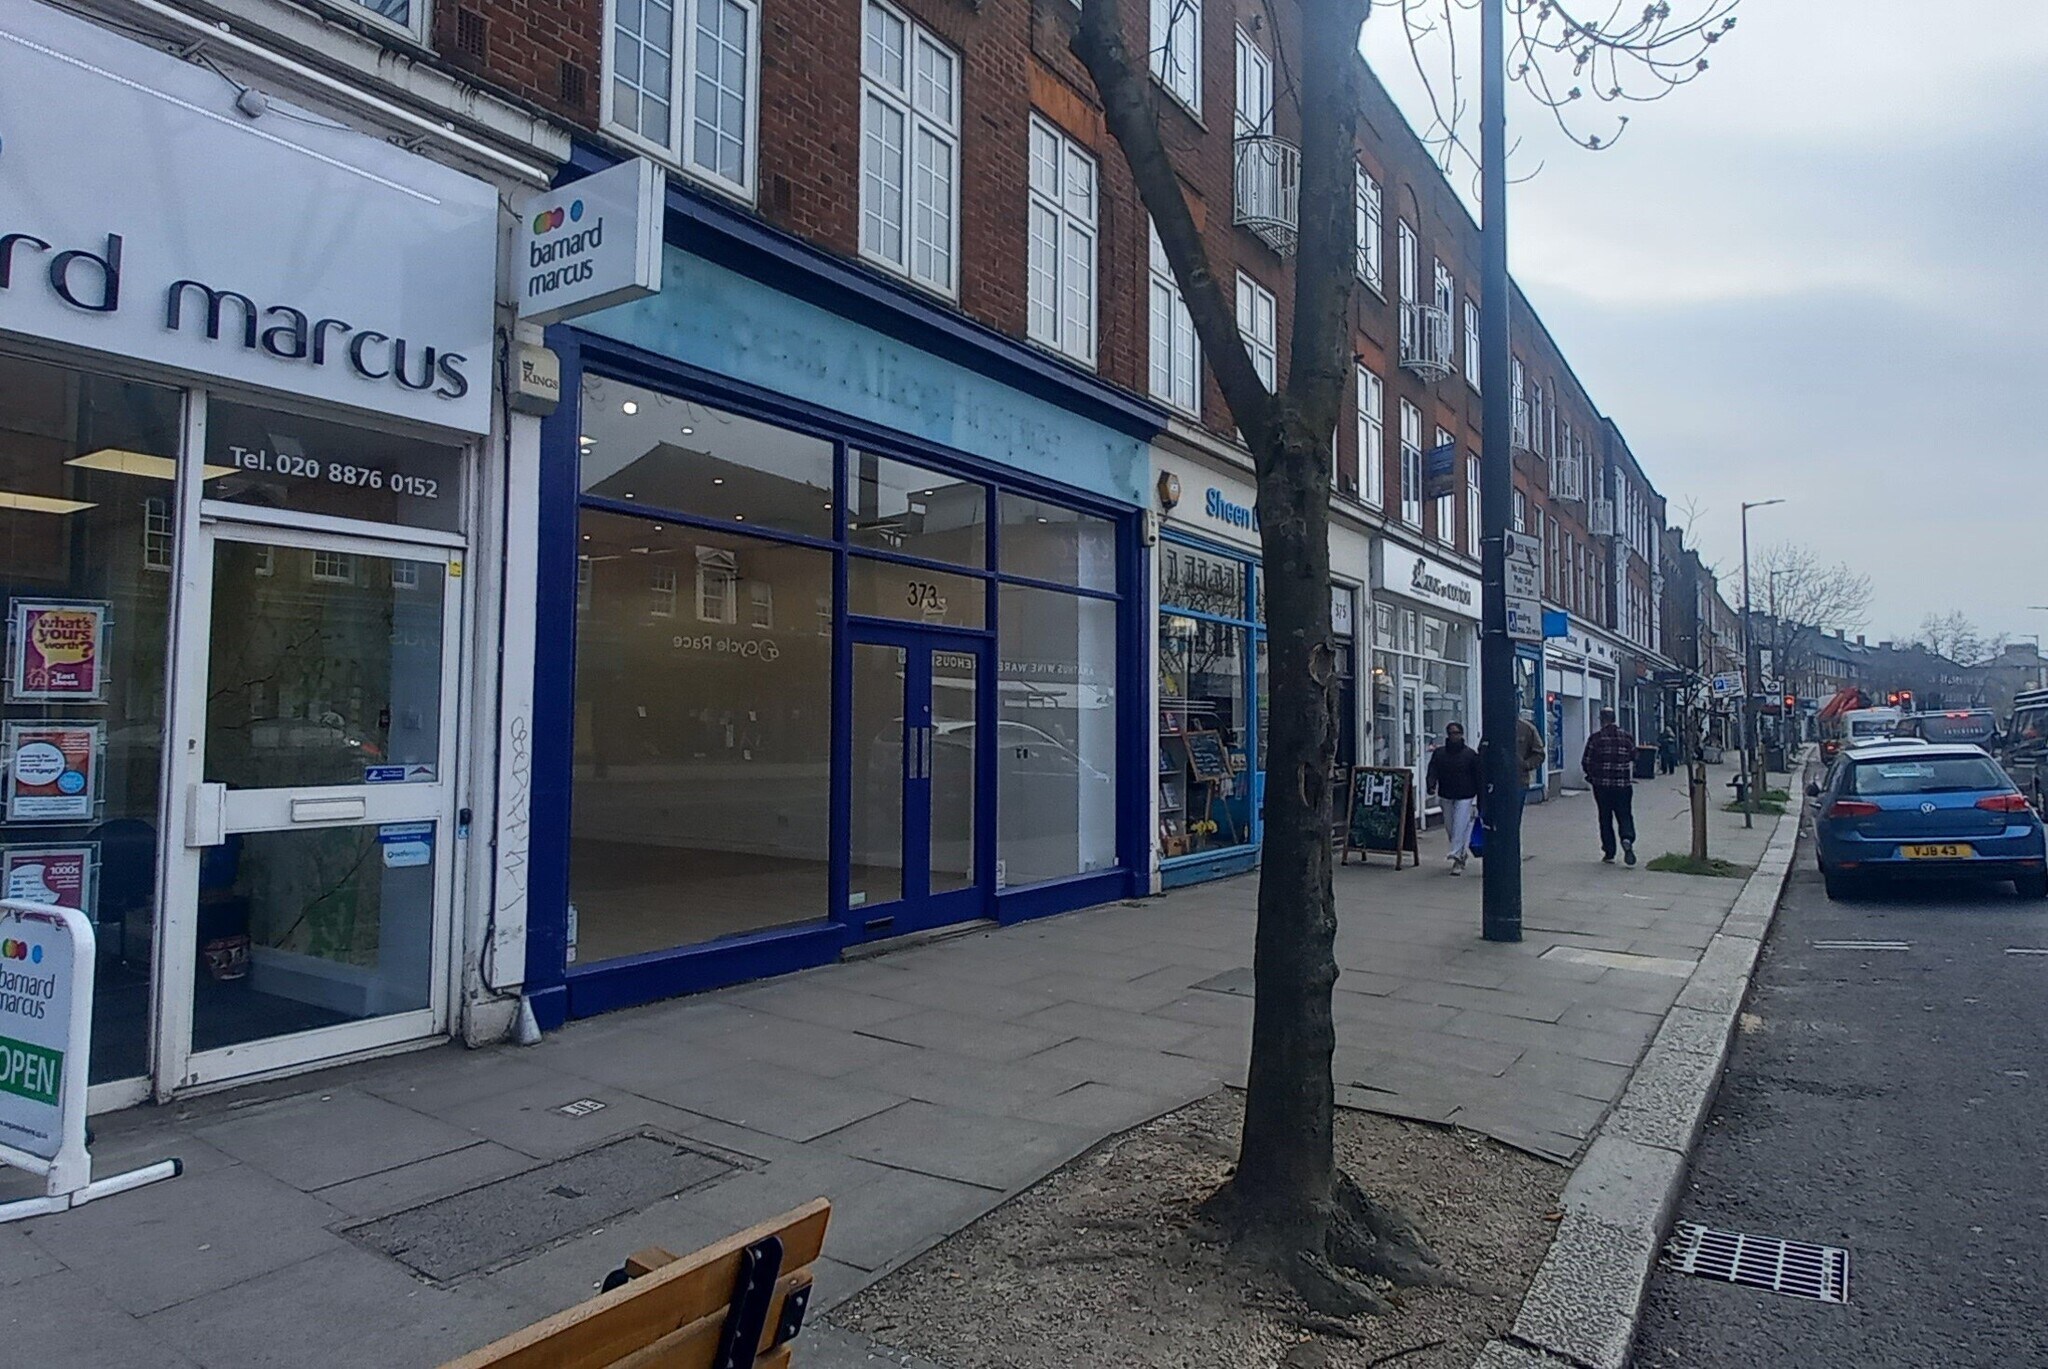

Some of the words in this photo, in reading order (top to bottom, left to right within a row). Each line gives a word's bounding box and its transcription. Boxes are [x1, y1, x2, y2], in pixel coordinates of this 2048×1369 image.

[530, 217, 603, 268] barnard
[528, 259, 593, 297] marcus
[166, 279, 469, 399] marcus
[523, 370, 559, 390] KINGS
[229, 446, 272, 471] Tel.
[276, 454, 320, 479] 020
[328, 463, 382, 489] 8876
[390, 474, 438, 499] 0152
[1205, 487, 1250, 530] Sheen
[907, 582, 938, 609] 373
[39, 616, 92, 629] what's
[1335, 603, 1347, 620] 375
[38, 629, 91, 642] yours
[1913, 846, 1938, 856] VJB
[1941, 845, 1957, 856] 43
[50, 866, 79, 875] 1000s
[0, 963, 55, 999] barnard
[0, 1045, 55, 1095] OPEN
